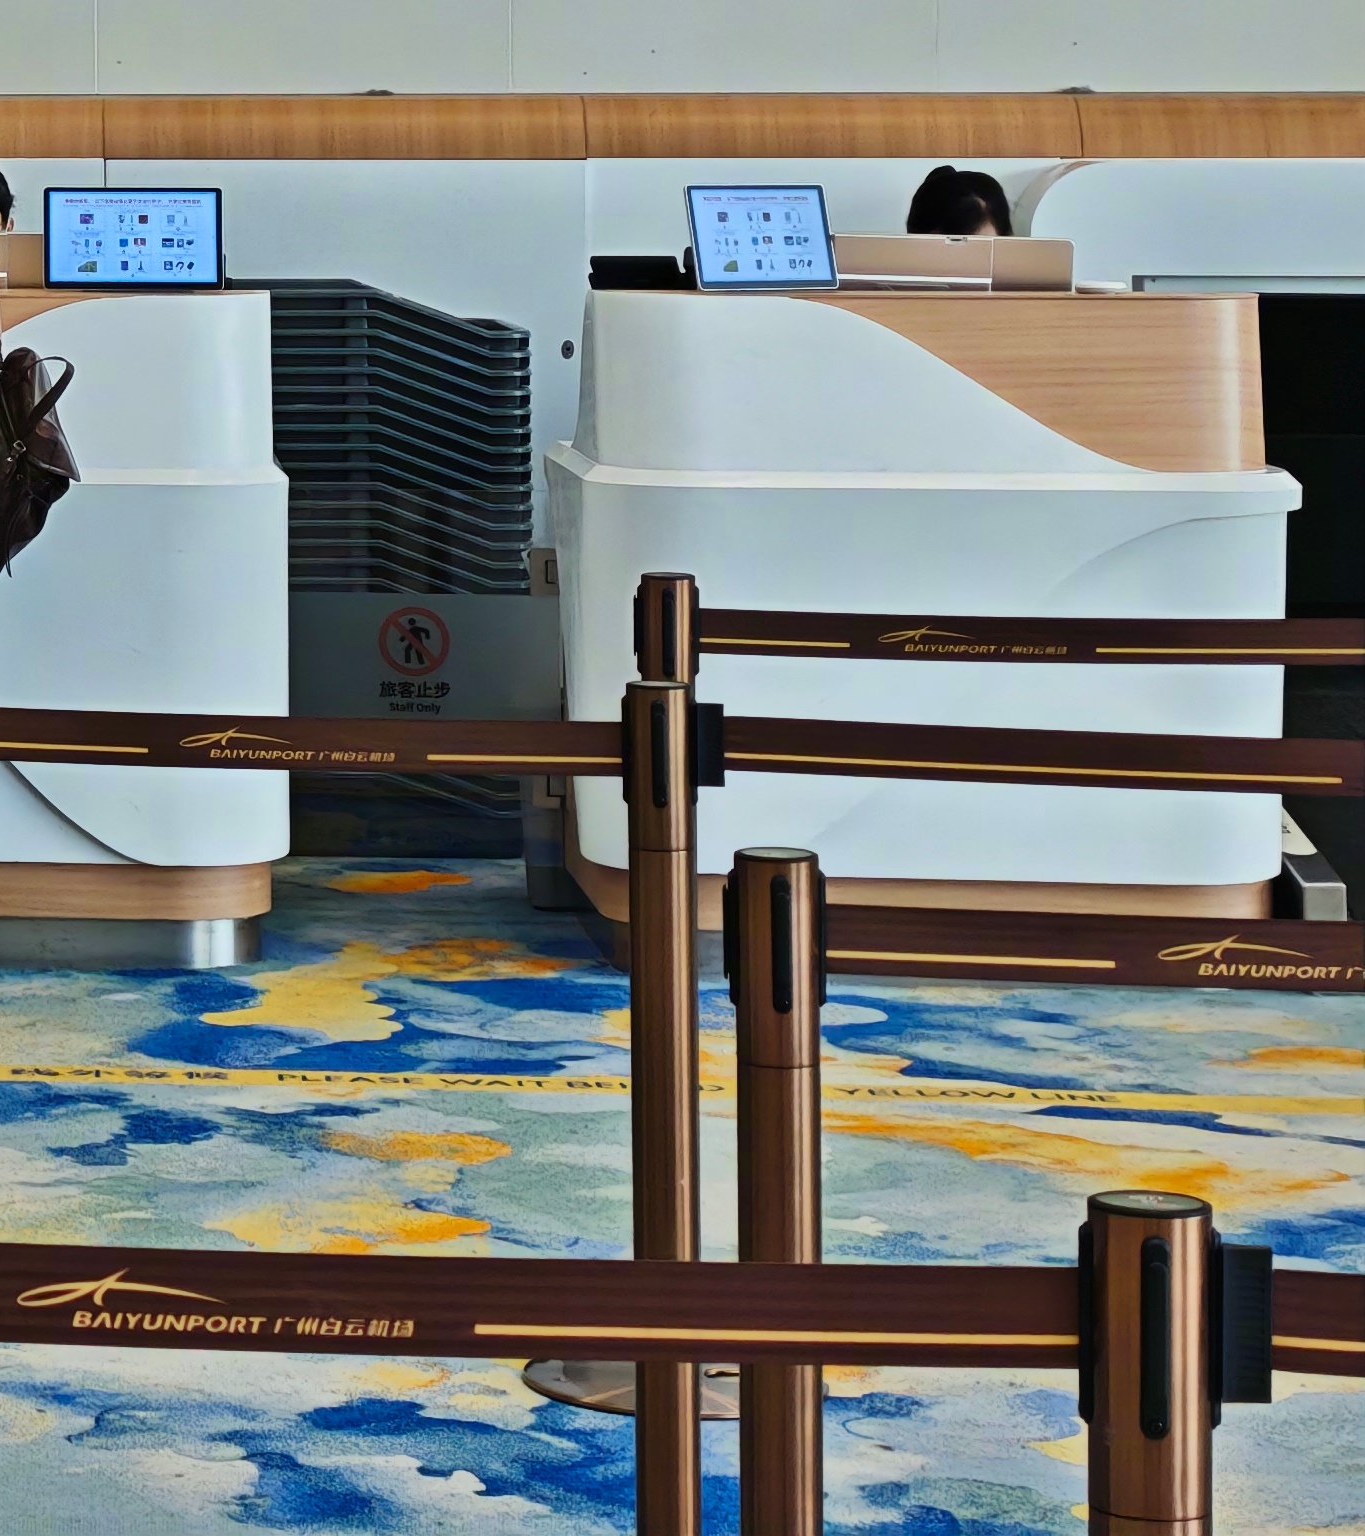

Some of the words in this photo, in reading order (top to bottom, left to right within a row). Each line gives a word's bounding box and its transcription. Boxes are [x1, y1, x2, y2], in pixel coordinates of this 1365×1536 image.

[904, 643, 998, 655] BAIYUNPORT
[379, 681, 451, 699] 旅客止步
[416, 703, 441, 715] Only
[209, 748, 316, 761] BAIYUNPORT
[1198, 962, 1342, 980] BAIYUNPORT
[277, 1073, 425, 1086] PLEASE
[439, 1077, 550, 1089] WAIT
[838, 1087, 1016, 1100] YELLOW
[1031, 1091, 1121, 1103] LINE
[72, 1310, 267, 1335] BAIYUNPORT
[273, 1317, 415, 1339] 广州白云机场
